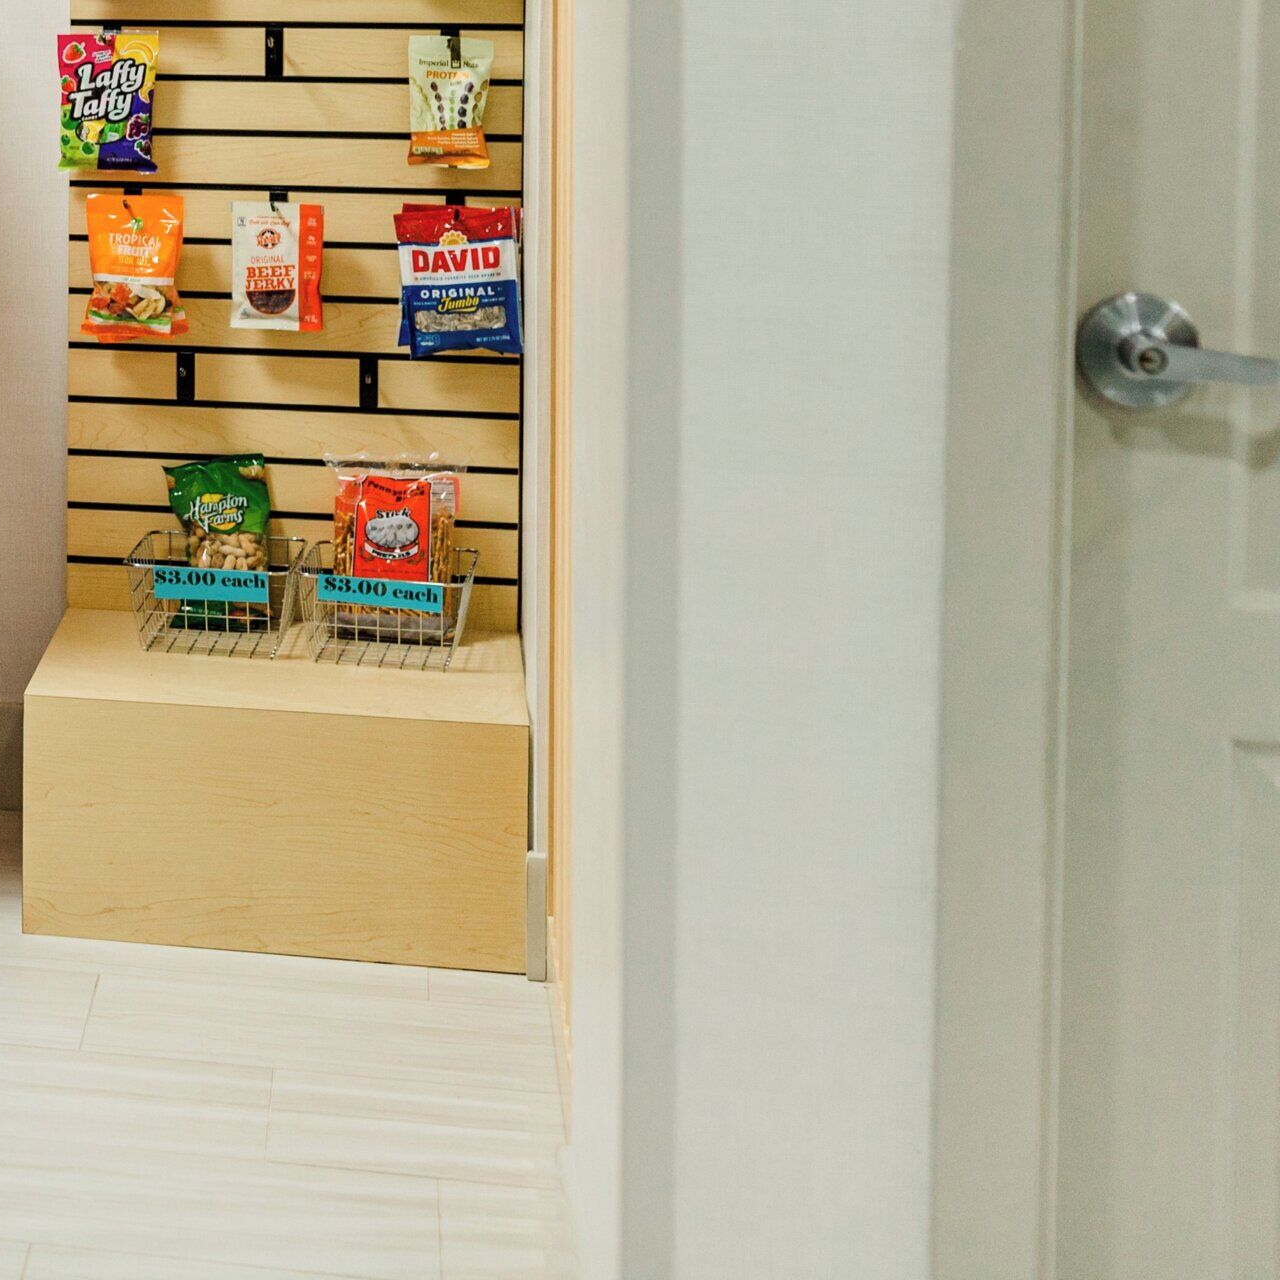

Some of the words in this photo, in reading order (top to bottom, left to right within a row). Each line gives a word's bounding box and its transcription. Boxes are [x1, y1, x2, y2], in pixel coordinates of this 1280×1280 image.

[77, 59, 145, 93] Laffy
[68, 88, 133, 121] Taffy
[411, 246, 501, 273] DAVID
[245, 277, 295, 290] JERKY
[246, 265, 296, 279] BEEF
[420, 286, 496, 299] ORIGINAL
[438, 295, 480, 312] Jumbo
[185, 493, 249, 521] Hampton
[200, 510, 244, 533] Farms
[154, 570, 217, 586] $3.00
[220, 574, 267, 589] each
[323, 577, 388, 597] $3.00
[392, 588, 439, 603] each
